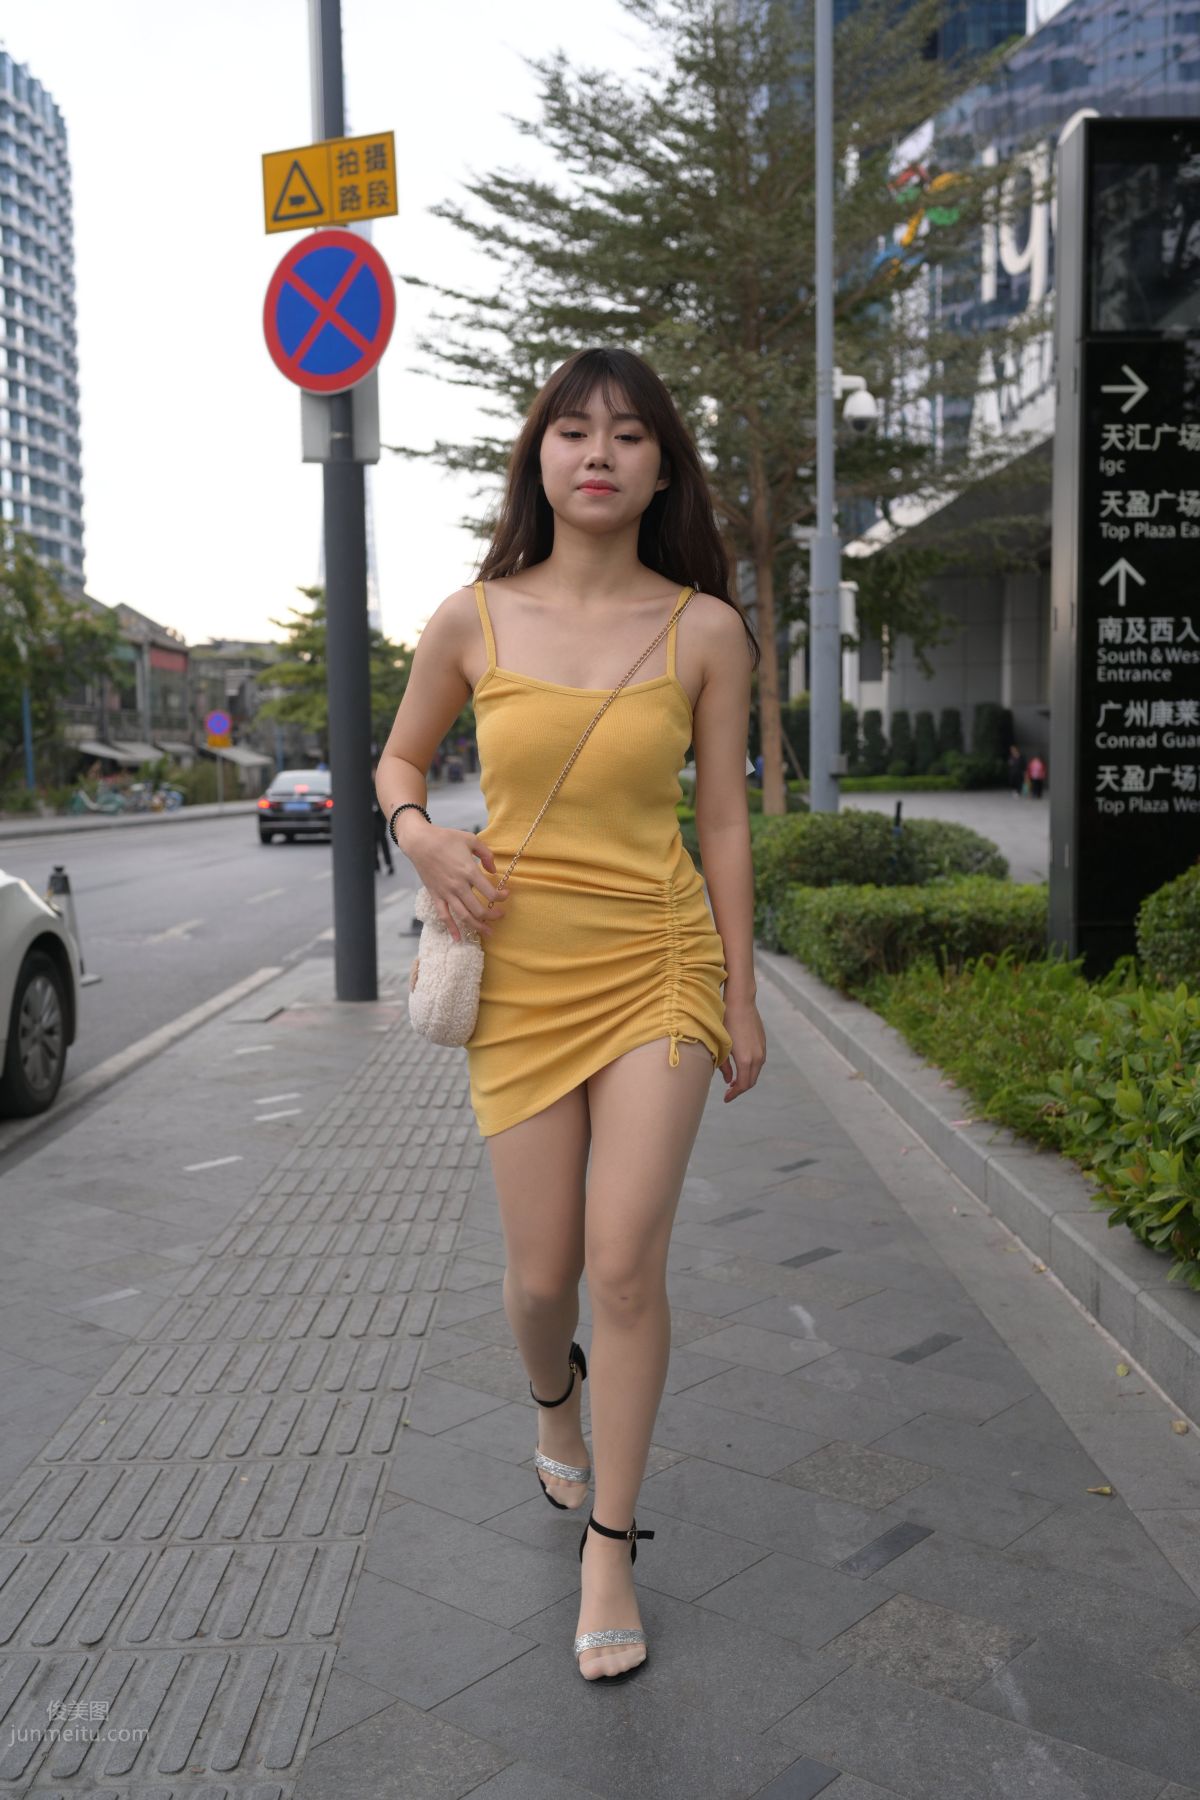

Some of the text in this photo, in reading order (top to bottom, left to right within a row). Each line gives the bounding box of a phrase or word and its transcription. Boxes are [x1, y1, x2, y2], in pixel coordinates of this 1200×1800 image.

[339, 180, 390, 212] 路段
[1101, 423, 1200, 451] 天汇广场
[1100, 457, 1125, 476] igc
[1100, 490, 1200, 518] 天盈广场
[1100, 522, 1130, 541] Top
[1134, 521, 1176, 538] Plaza
[1098, 616, 1200, 644] 南及西入
[1097, 647, 1147, 664] South
[1150, 647, 1163, 664] &
[1096, 666, 1172, 682] Entrance
[1095, 732, 1157, 748] Conrad
[1096, 765, 1200, 793] 天盈广场
[1096, 797, 1125, 816] Top
[1129, 796, 1169, 813] Plaza
